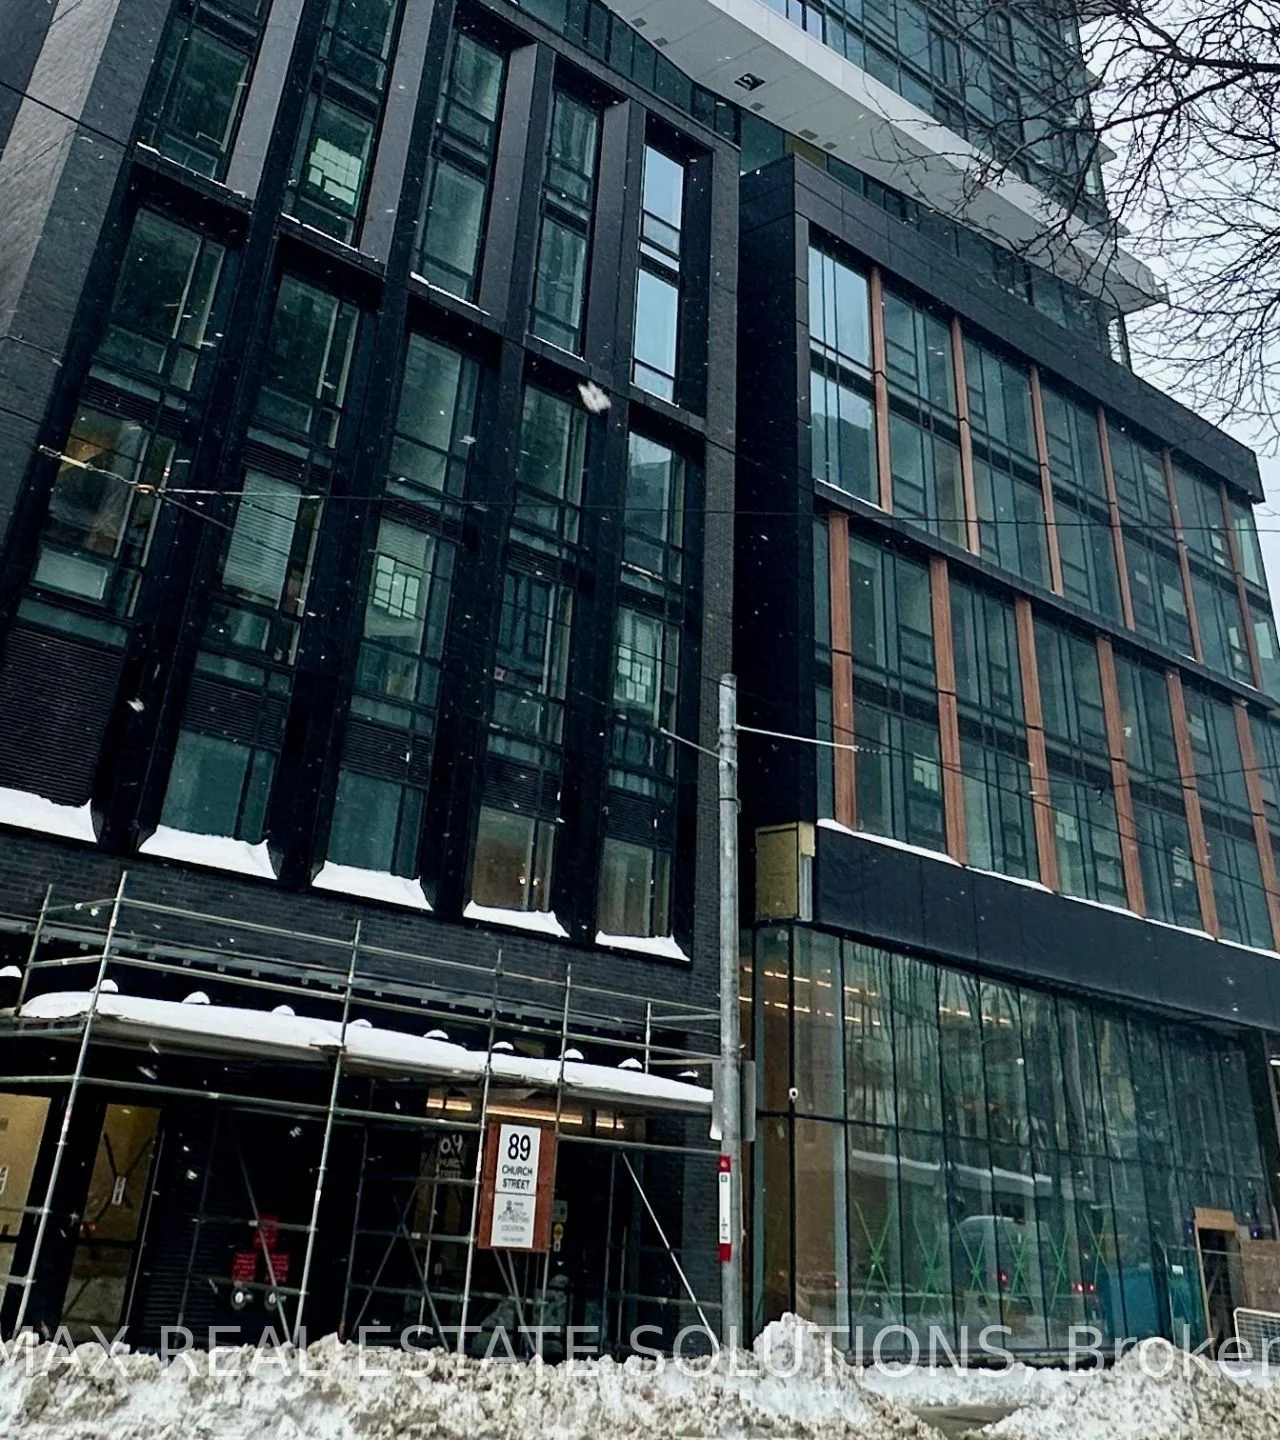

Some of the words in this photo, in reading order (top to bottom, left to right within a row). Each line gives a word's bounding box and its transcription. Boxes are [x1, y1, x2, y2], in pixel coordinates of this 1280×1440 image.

[508, 1133, 532, 1162] 89
[501, 1164, 533, 1177] CHURCH
[502, 1178, 531, 1190] STREET
